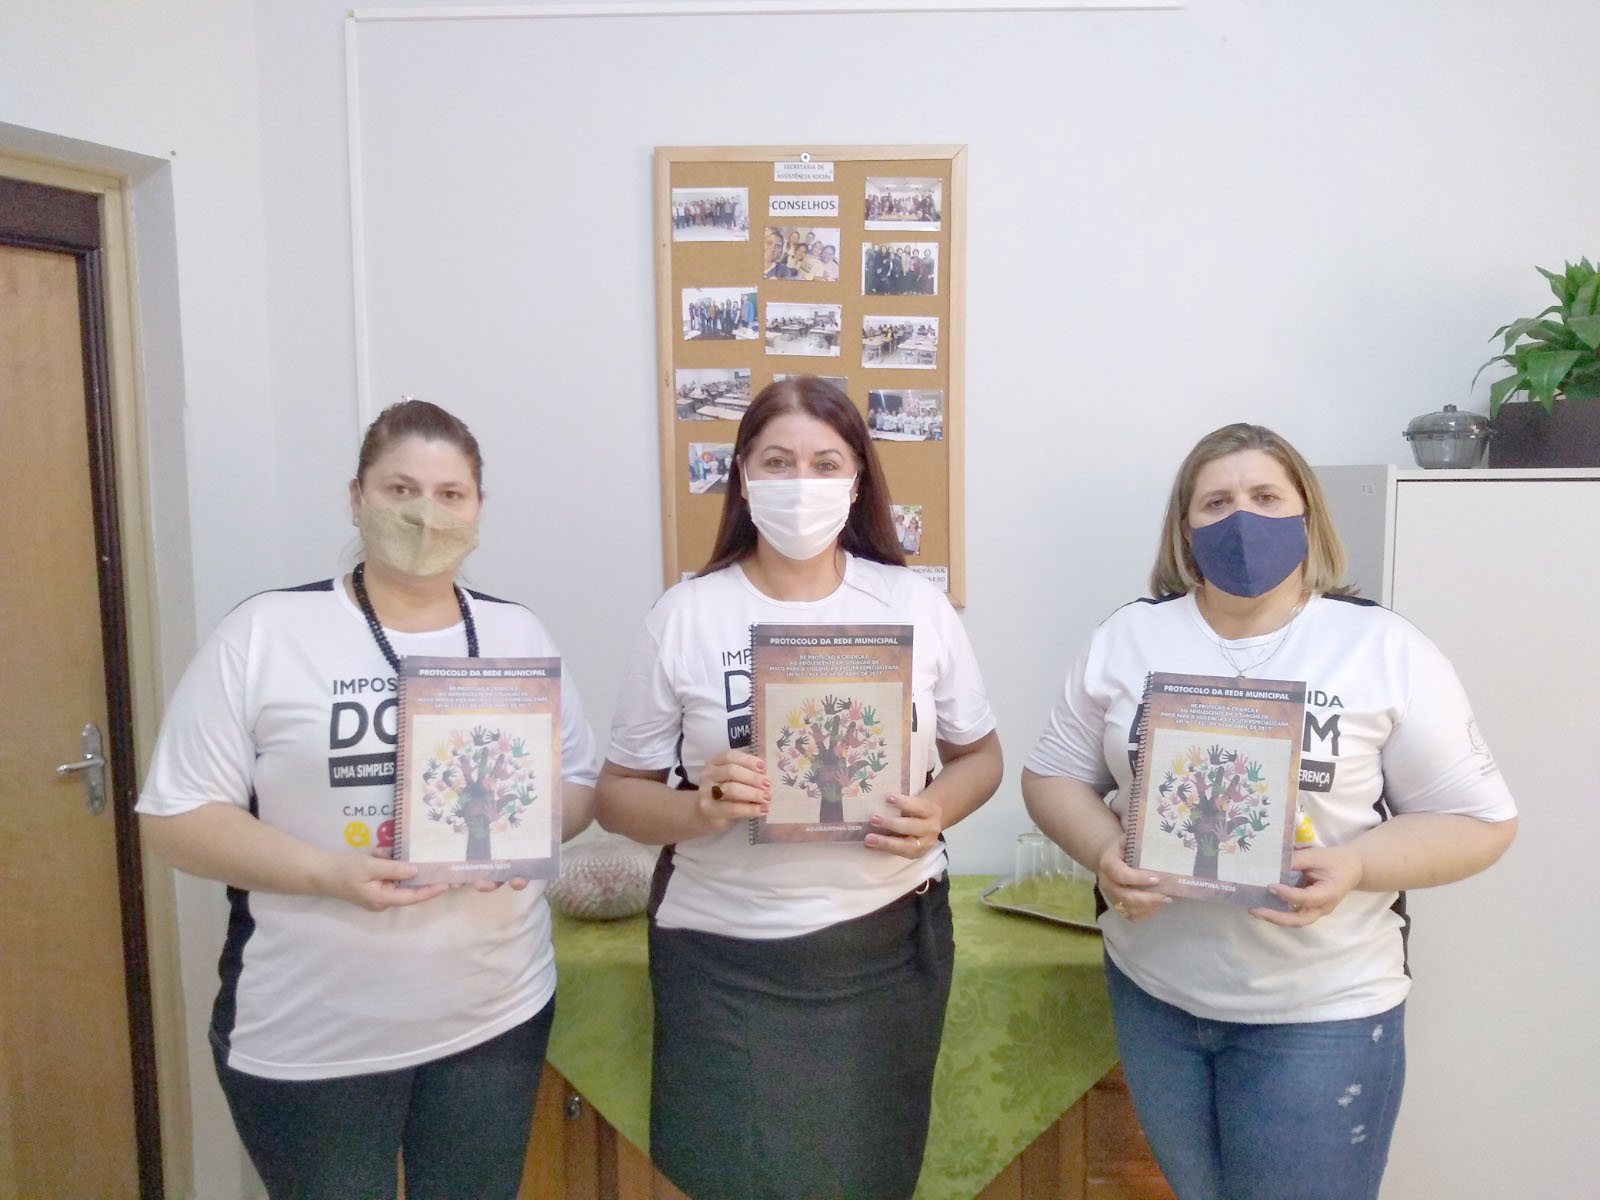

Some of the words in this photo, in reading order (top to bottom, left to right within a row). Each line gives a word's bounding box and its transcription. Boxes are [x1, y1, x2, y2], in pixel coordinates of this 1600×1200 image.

[771, 200, 835, 211] CONSELHOS
[769, 637, 818, 646] PROTOCOLO
[820, 637, 832, 645] DA
[833, 637, 853, 645] REDE
[854, 636, 899, 645] MUNICIPAL
[419, 668, 468, 678] PROTOCOLO
[469, 669, 482, 677] DA
[482, 668, 502, 677] REDE
[503, 668, 547, 678] MUNICIPAL
[1164, 685, 1210, 695] PROTOCOLO
[1211, 688, 1223, 696] DA
[1224, 689, 1244, 697] REDE
[1245, 690, 1290, 700] MUNICIPAL
[730, 724, 751, 739] UMA
[1302, 711, 1341, 757] M
[333, 765, 356, 779] UMA
[356, 761, 395, 778] SIMPLES
